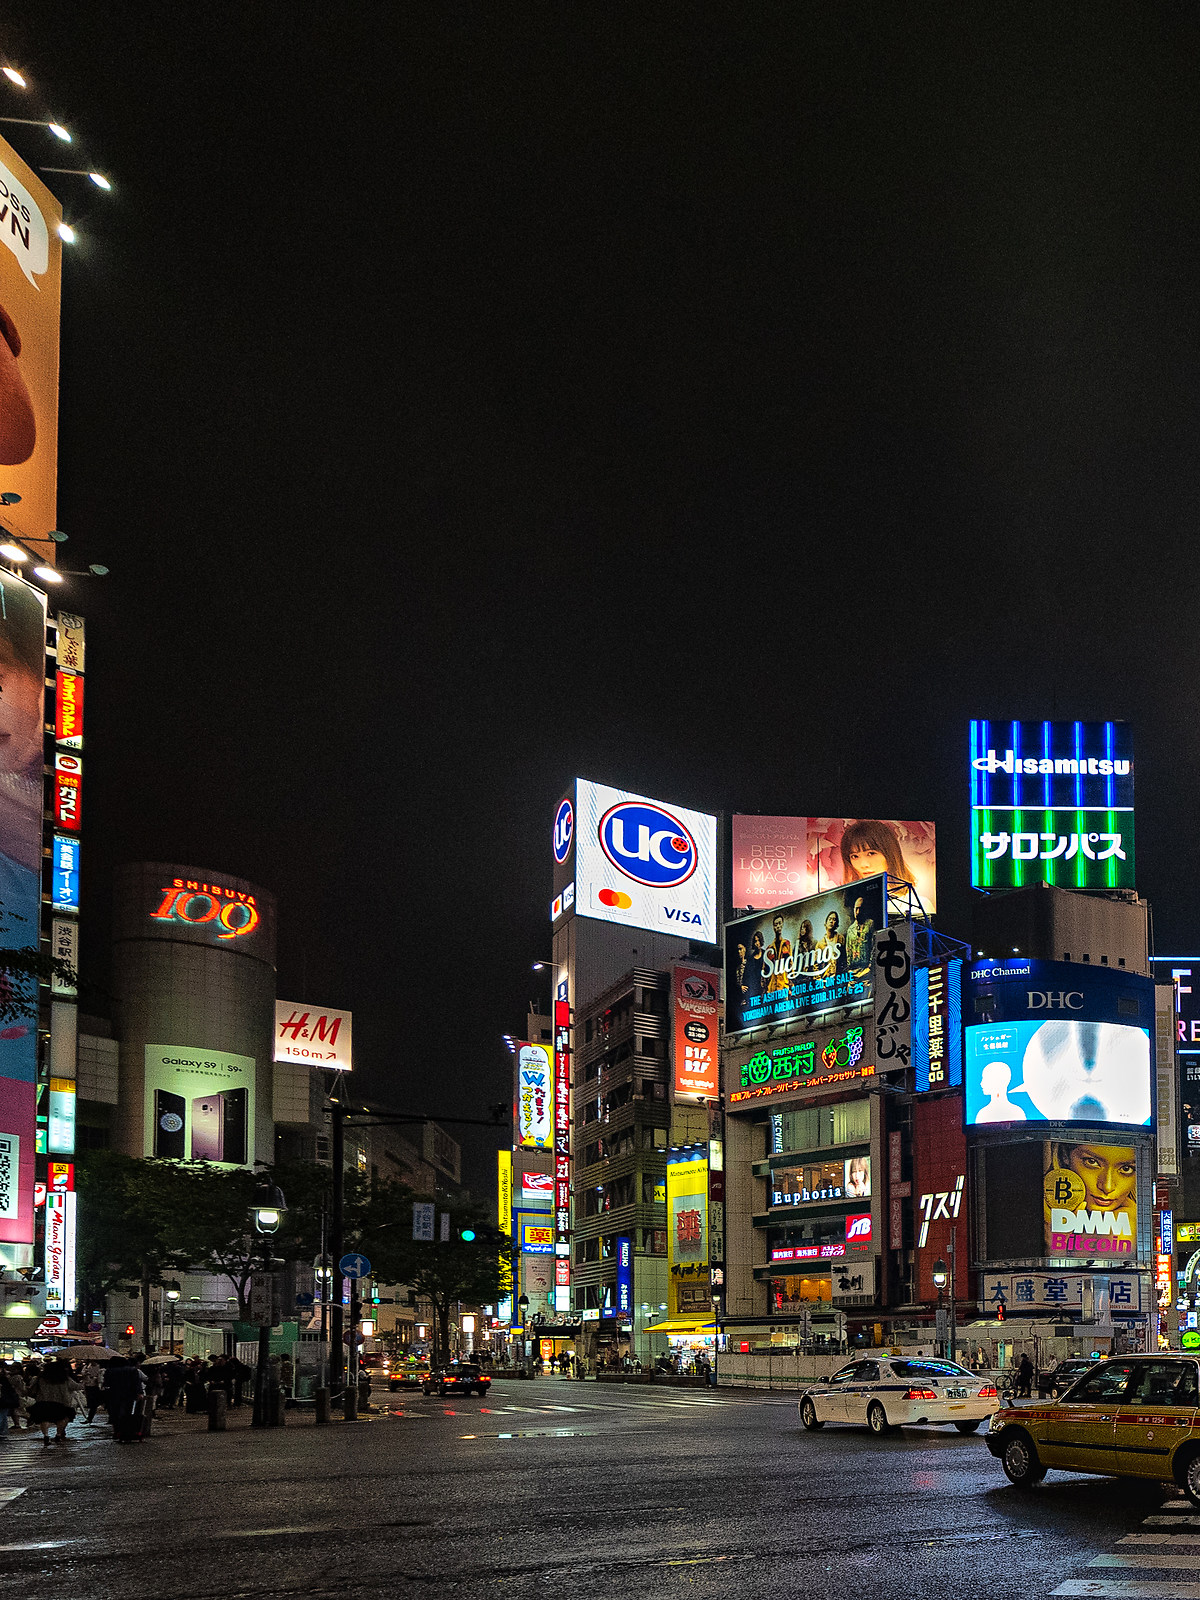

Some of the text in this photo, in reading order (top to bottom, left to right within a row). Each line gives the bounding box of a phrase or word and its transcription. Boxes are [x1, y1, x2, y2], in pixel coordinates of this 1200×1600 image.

[972, 750, 1130, 775] Hisamitsu
[59, 786, 78, 822] ガスト
[751, 845, 797, 858] BEST
[980, 832, 1127, 860] サロンパス
[740, 857, 788, 871] LOVE
[750, 871, 801, 884] MACO
[173, 878, 256, 906] SHIBUYA
[745, 887, 765, 895] 6.20
[778, 887, 794, 896] sale
[150, 887, 259, 939] 109
[663, 906, 702, 926] VISA
[761, 938, 842, 980] Suchmos
[836, 971, 854, 985] SALE
[970, 965, 1030, 980] DHC Channel
[795, 994, 810, 1009] LIVE
[875, 929, 911, 1066] もんじゃ
[1027, 991, 1084, 1010] DHC
[279, 1010, 342, 1047] H&M
[928, 967, 944, 1082] 三千里薬品
[161, 1056, 203, 1071] Galaxy
[204, 1060, 217, 1069] S9
[772, 1050, 815, 1080] 西村
[773, 1185, 842, 1206] Euphoria
[677, 1208, 701, 1241] 薬
[847, 1217, 871, 1239] JTB
[1051, 1208, 1132, 1235] DMM
[621, 1242, 629, 1267] MIZUHO
[1051, 1234, 1132, 1253] Bitcoin
[990, 1278, 1132, 1304] 大盛堂店
